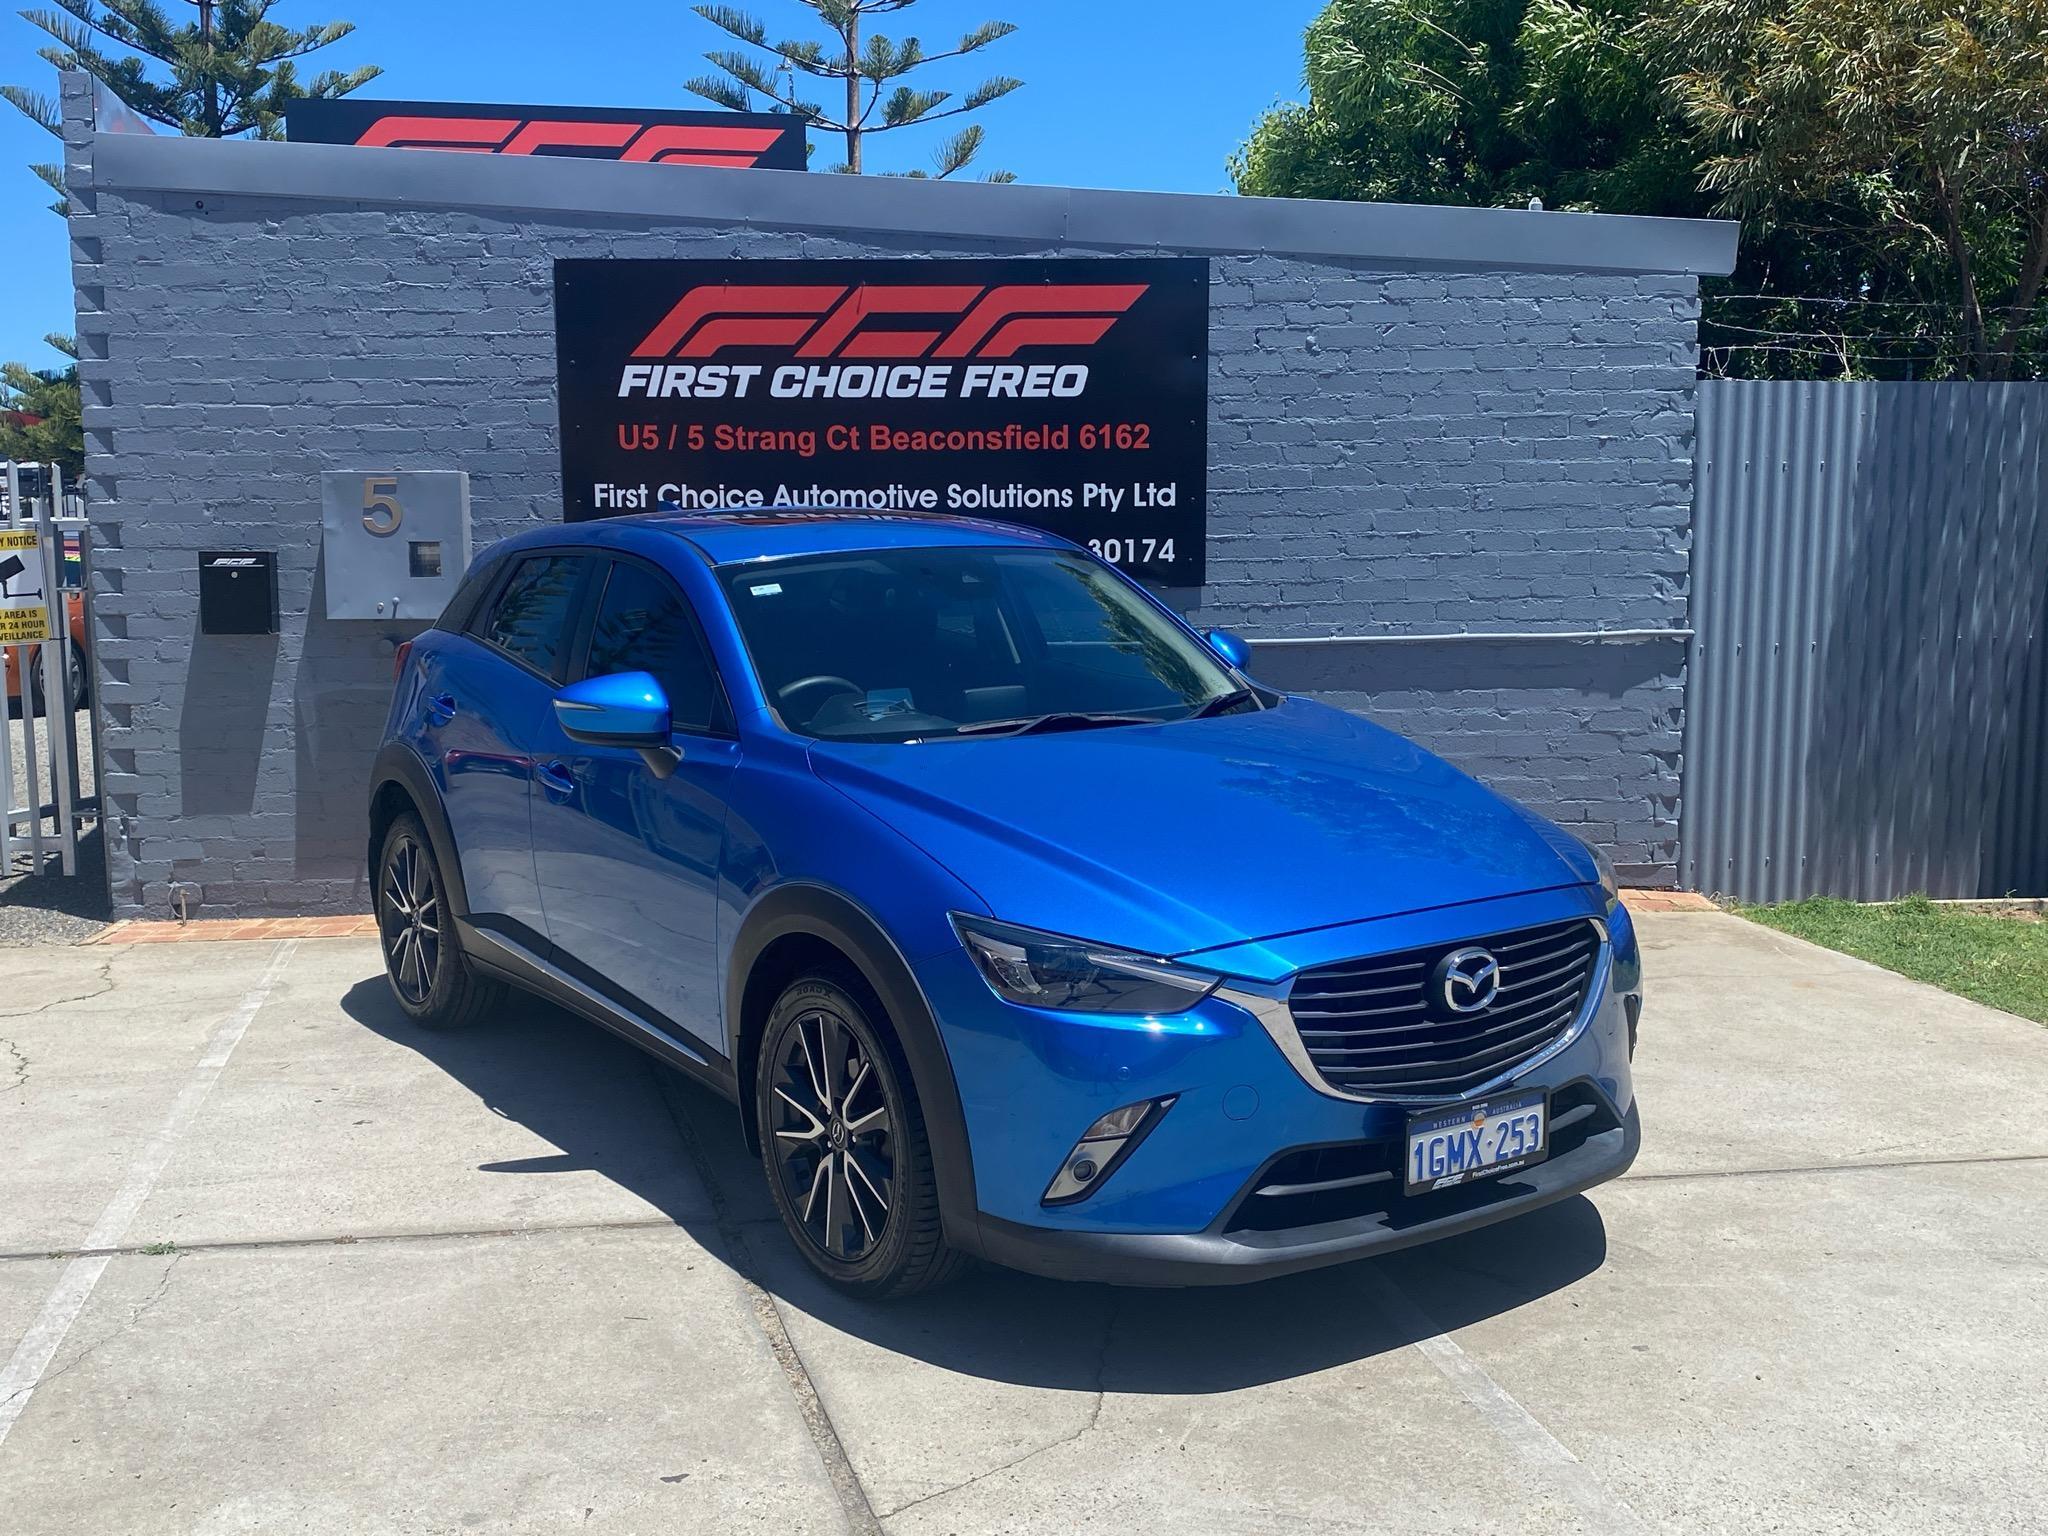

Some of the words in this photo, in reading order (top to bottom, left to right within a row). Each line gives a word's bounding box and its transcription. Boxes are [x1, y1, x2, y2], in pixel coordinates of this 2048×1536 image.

[618, 365, 761, 398] FIRST
[769, 365, 953, 398] CHOICE
[960, 364, 1089, 397] FREO
[618, 424, 659, 450] U5
[668, 424, 678, 450] /
[687, 424, 705, 450] 5
[714, 423, 816, 456] Strang
[826, 424, 860, 450] Ct
[870, 423, 1069, 451] Beaconsfield
[1079, 424, 1151, 450] 6162
[362, 477, 402, 536] 5
[594, 483, 648, 508] First
[657, 483, 764, 509] Choice
[772, 483, 938, 508] Automotive
[947, 483, 1073, 509] Solutions
[1083, 482, 1125, 512] Pty
[1133, 482, 1176, 507] Ltd
[7, 535, 38, 547] NOTICE
[1088, 538, 1176, 564] 30174
[4, 610, 27, 619] AREA
[29, 609, 38, 618] IS
[8, 621, 19, 630] 24
[21, 620, 45, 629] HOUR
[1433, 1116, 1466, 1129] WESTERN
[1492, 1102, 1522, 1115] AUSTRALIA
